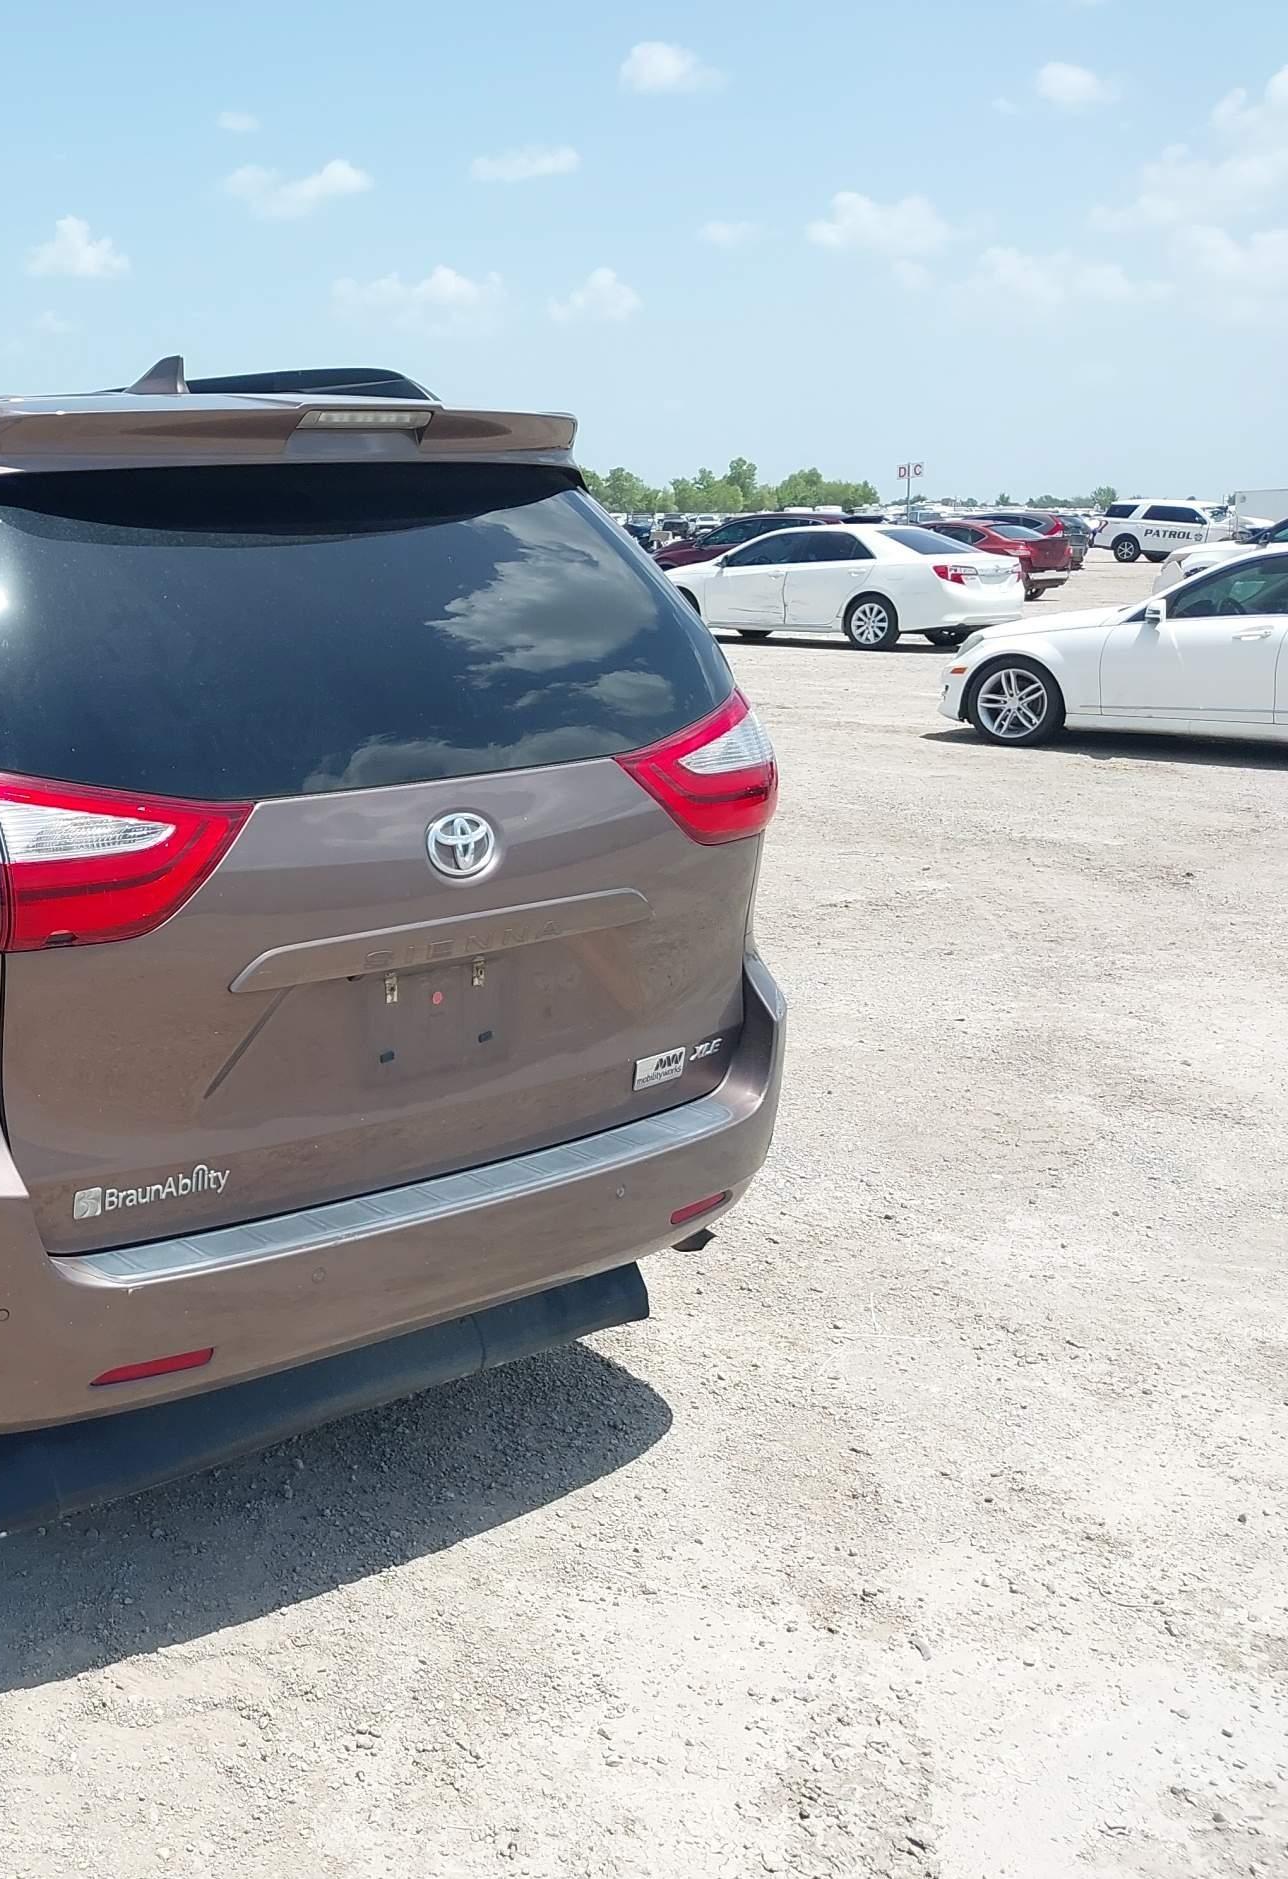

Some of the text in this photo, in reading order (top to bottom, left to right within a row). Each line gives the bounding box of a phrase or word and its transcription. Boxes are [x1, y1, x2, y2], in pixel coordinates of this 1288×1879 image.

[898, 466, 907, 478] D
[913, 463, 923, 476] C
[1144, 528, 1193, 540] PATROL
[364, 919, 562, 970] SIENNA
[689, 1038, 723, 1061] XLE
[105, 1164, 231, 1211] BraunAbility
